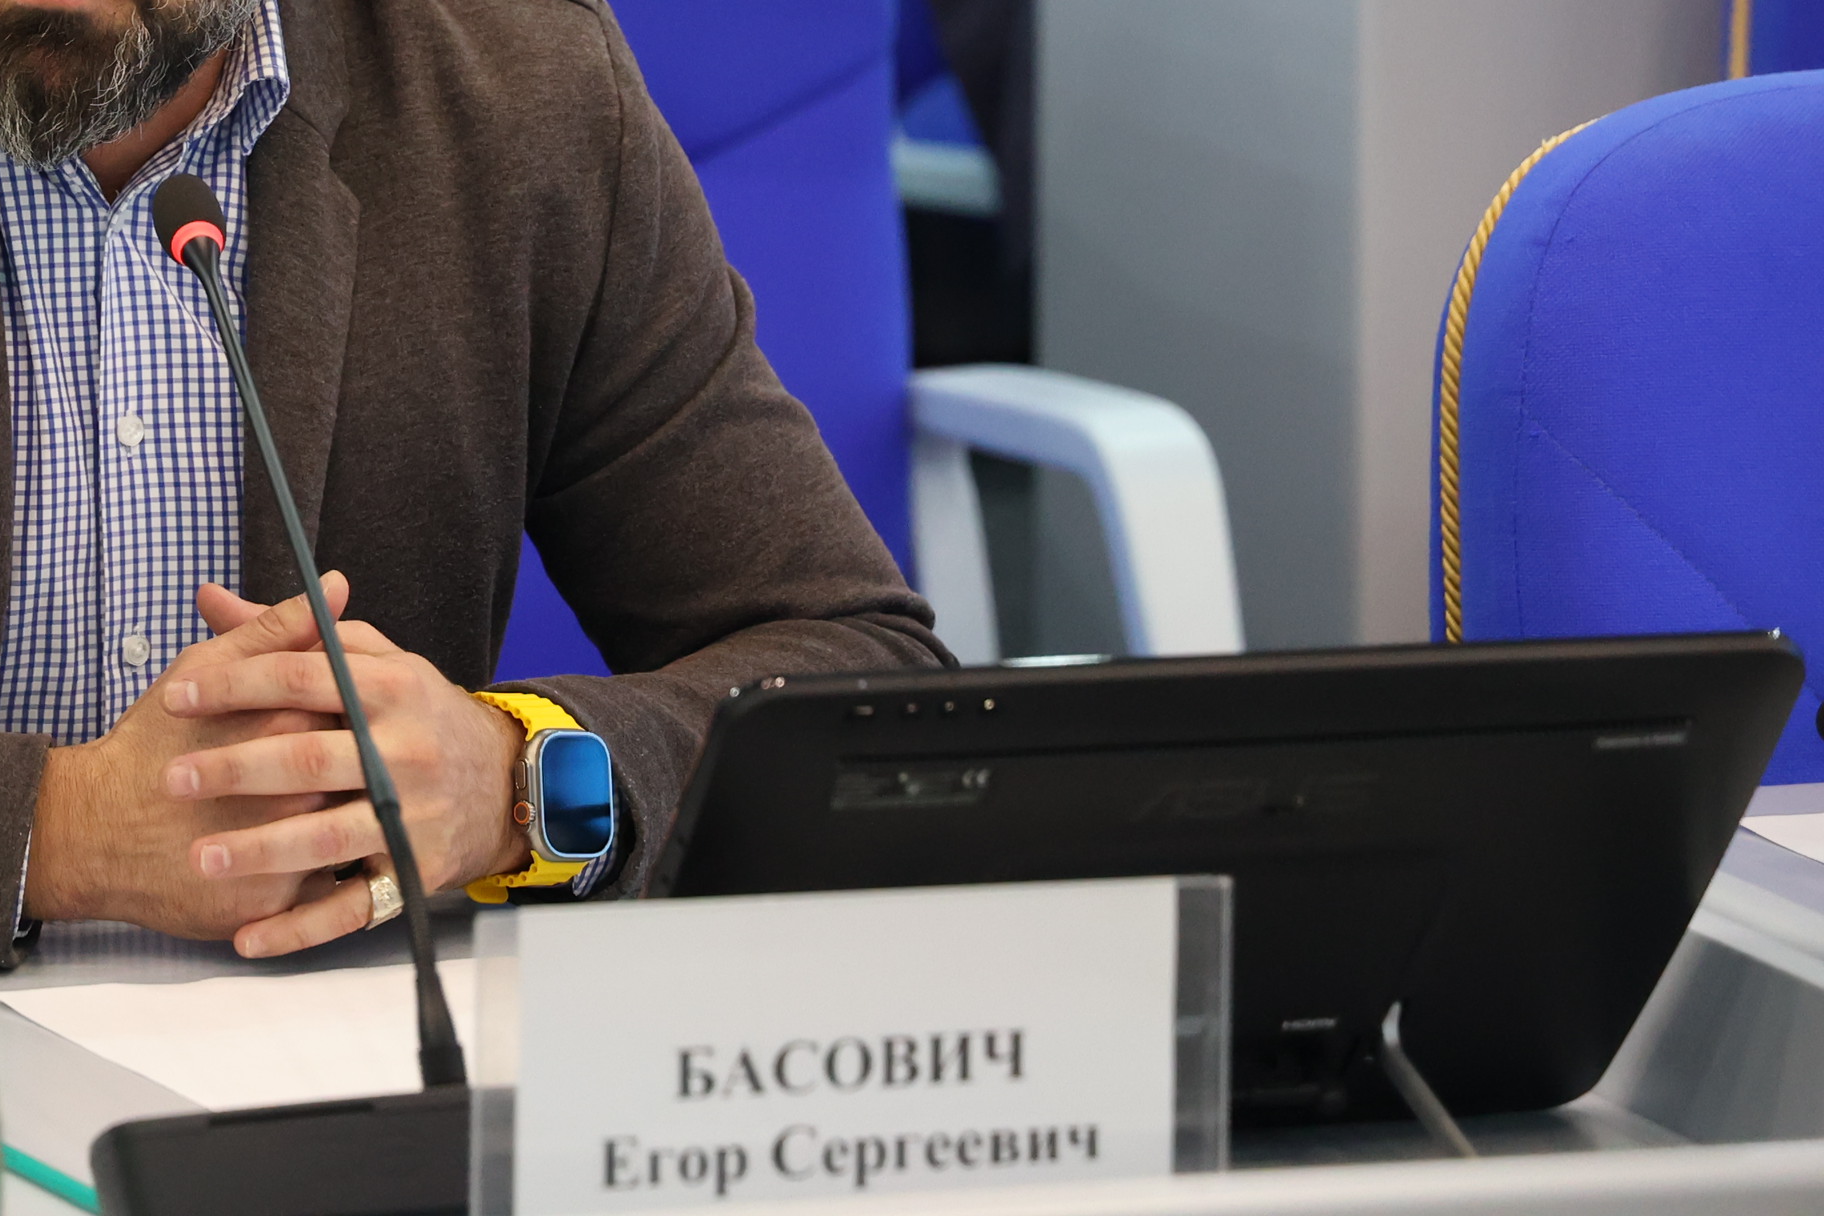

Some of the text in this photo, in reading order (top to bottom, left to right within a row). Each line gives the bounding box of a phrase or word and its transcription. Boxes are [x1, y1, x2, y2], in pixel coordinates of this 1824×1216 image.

[676, 1028, 1025, 1101] БАСОВИЧ
[601, 1124, 1100, 1197] Егор Сергеевич
